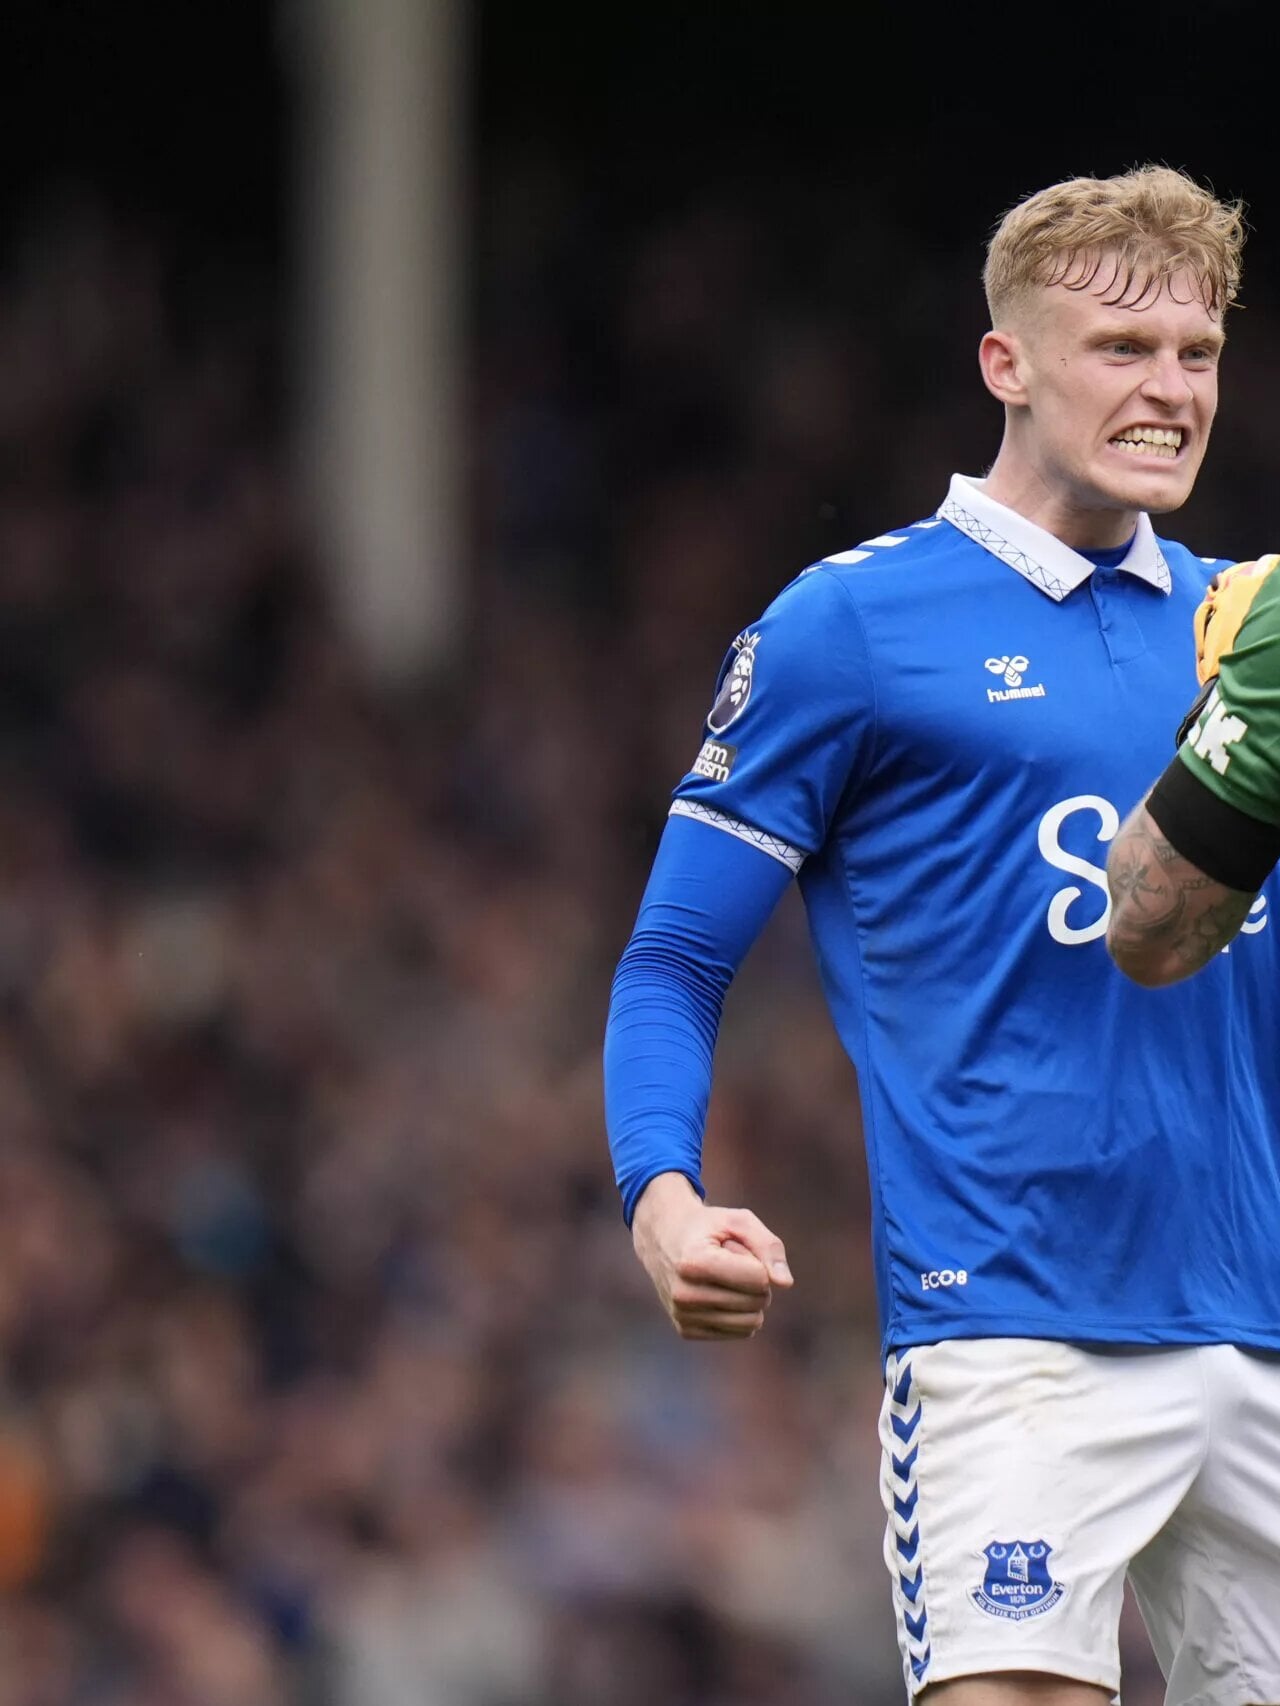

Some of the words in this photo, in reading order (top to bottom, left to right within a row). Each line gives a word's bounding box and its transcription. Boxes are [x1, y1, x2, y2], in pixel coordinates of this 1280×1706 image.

[986, 683, 1046, 703] hummel
[920, 1269, 968, 1291] ECO8
[991, 1583, 1044, 1596] Everton
